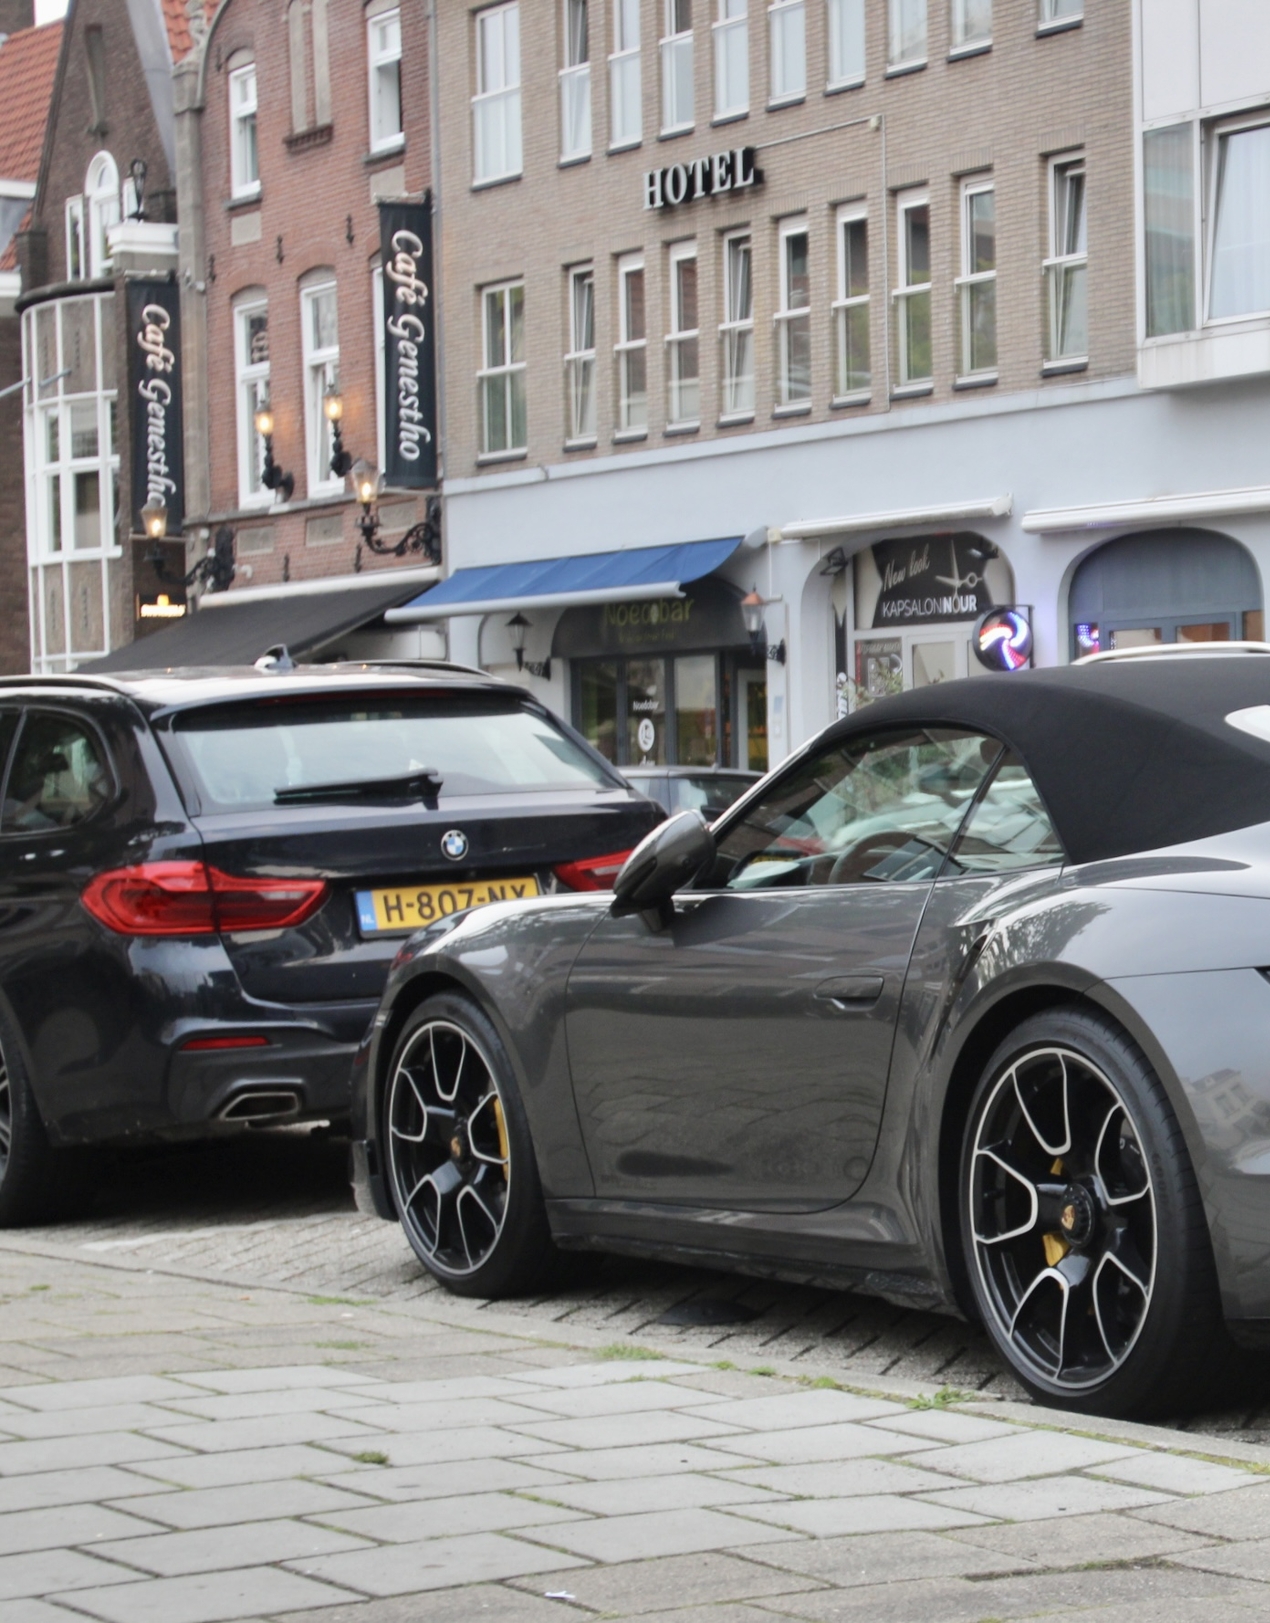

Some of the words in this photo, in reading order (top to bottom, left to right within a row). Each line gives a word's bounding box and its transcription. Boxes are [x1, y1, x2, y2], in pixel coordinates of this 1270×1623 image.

[643, 147, 755, 209] HOTEL
[386, 229, 429, 307] Café
[137, 303, 175, 373] Café
[387, 313, 431, 462] Genestho
[883, 558, 906, 592] New
[909, 543, 931, 578] look
